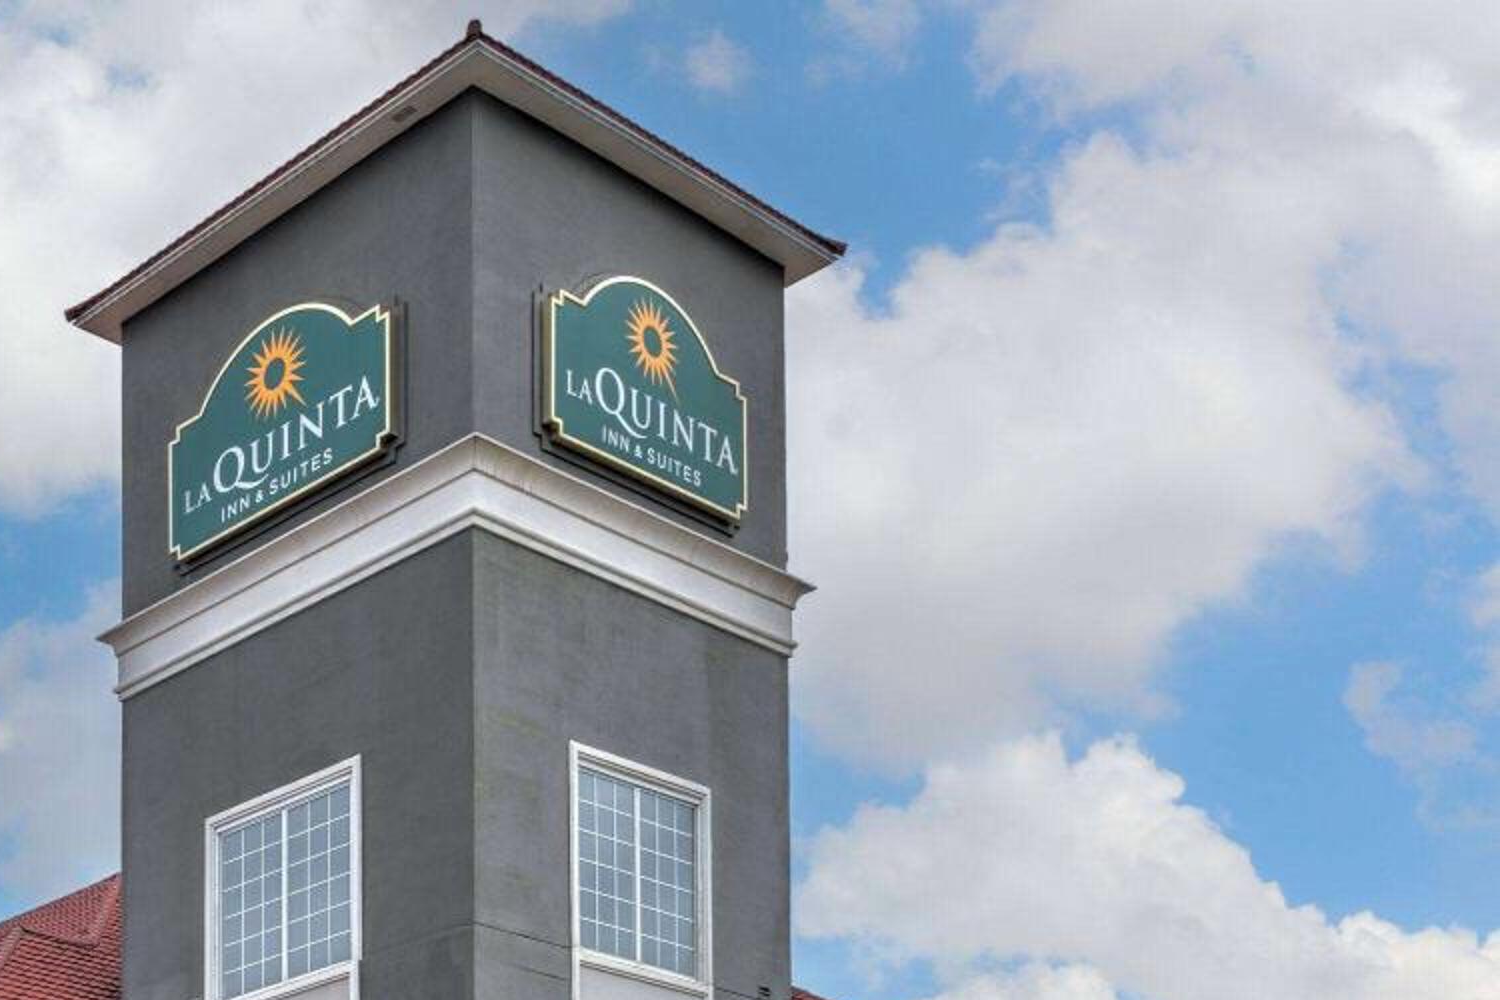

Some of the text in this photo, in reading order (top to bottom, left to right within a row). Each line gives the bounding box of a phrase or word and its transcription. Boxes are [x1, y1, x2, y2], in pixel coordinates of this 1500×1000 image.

[183, 375, 380, 514] LA QUINTA
[566, 367, 738, 476] LA QUINTA
[602, 425, 702, 487] INN & SUITES
[220, 447, 333, 523] INN & SUITES
